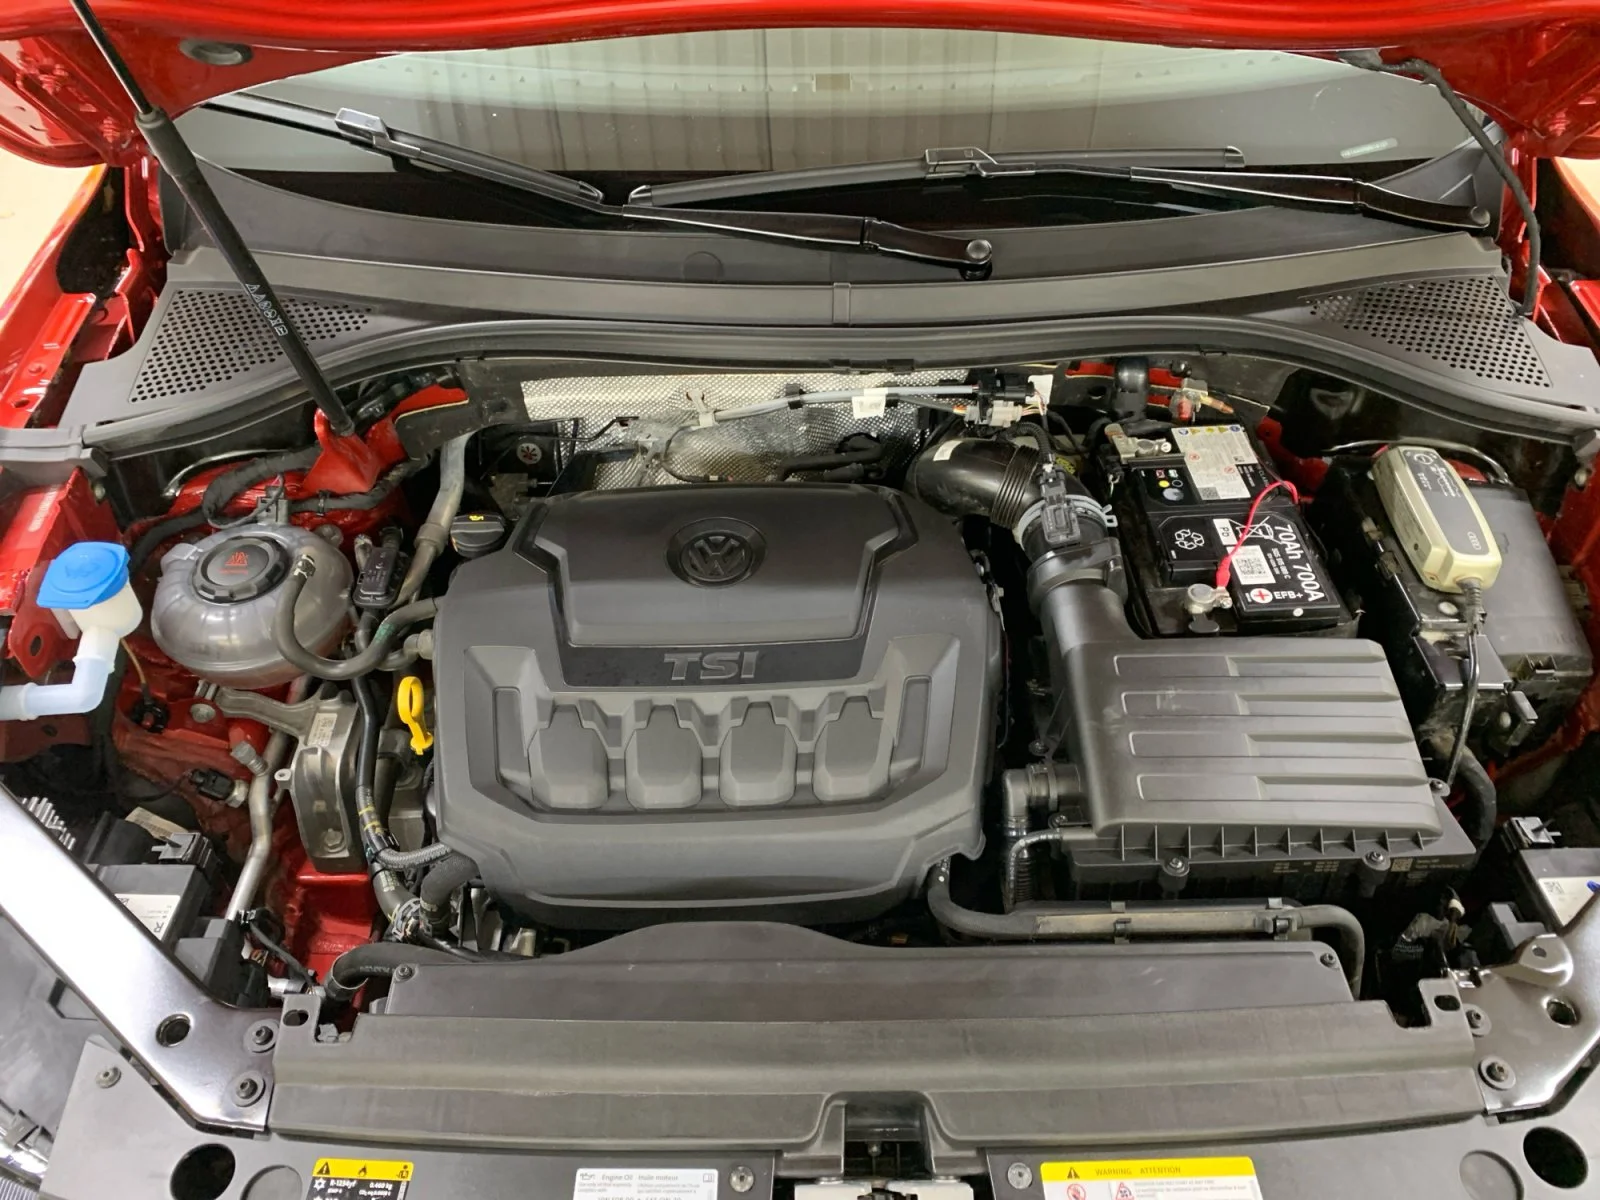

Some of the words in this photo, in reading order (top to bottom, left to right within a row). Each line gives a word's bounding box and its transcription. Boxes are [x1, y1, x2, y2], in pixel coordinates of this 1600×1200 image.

[1219, 526, 1230, 538] Pb
[1274, 524, 1304, 560] 70Ah
[1293, 563, 1325, 602] 700A
[1273, 590, 1304, 600] EFB+
[664, 650, 760, 680] TSI
[1094, 1167, 1133, 1177] WARNING
[1139, 1165, 1181, 1175] ATTENTION
[601, 1174, 624, 1182] Engine
